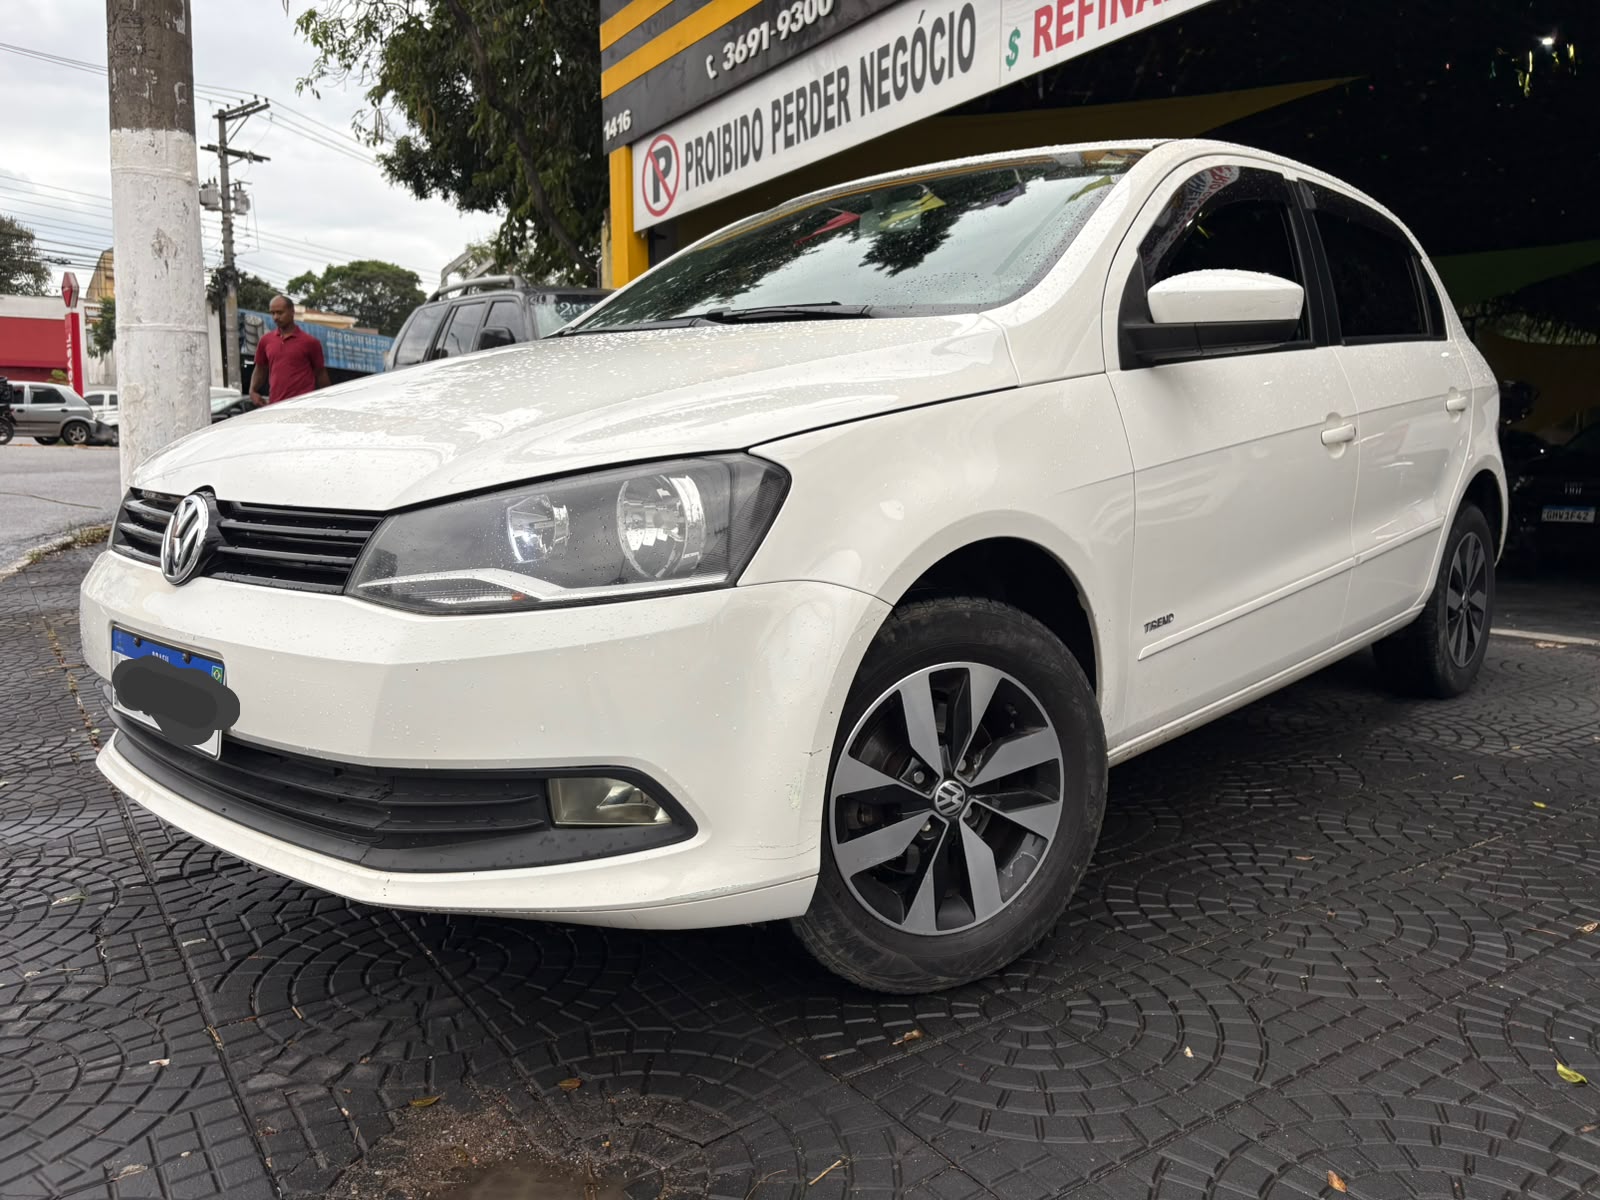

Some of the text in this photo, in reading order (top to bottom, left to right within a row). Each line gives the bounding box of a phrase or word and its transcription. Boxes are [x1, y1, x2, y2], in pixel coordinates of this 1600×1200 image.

[722, 0, 835, 71] 3691-9300
[685, 2, 976, 191] PROIBIDO PERDER NEGÓCIO
[603, 109, 632, 141] 1416
[1144, 613, 1175, 634] TREND
